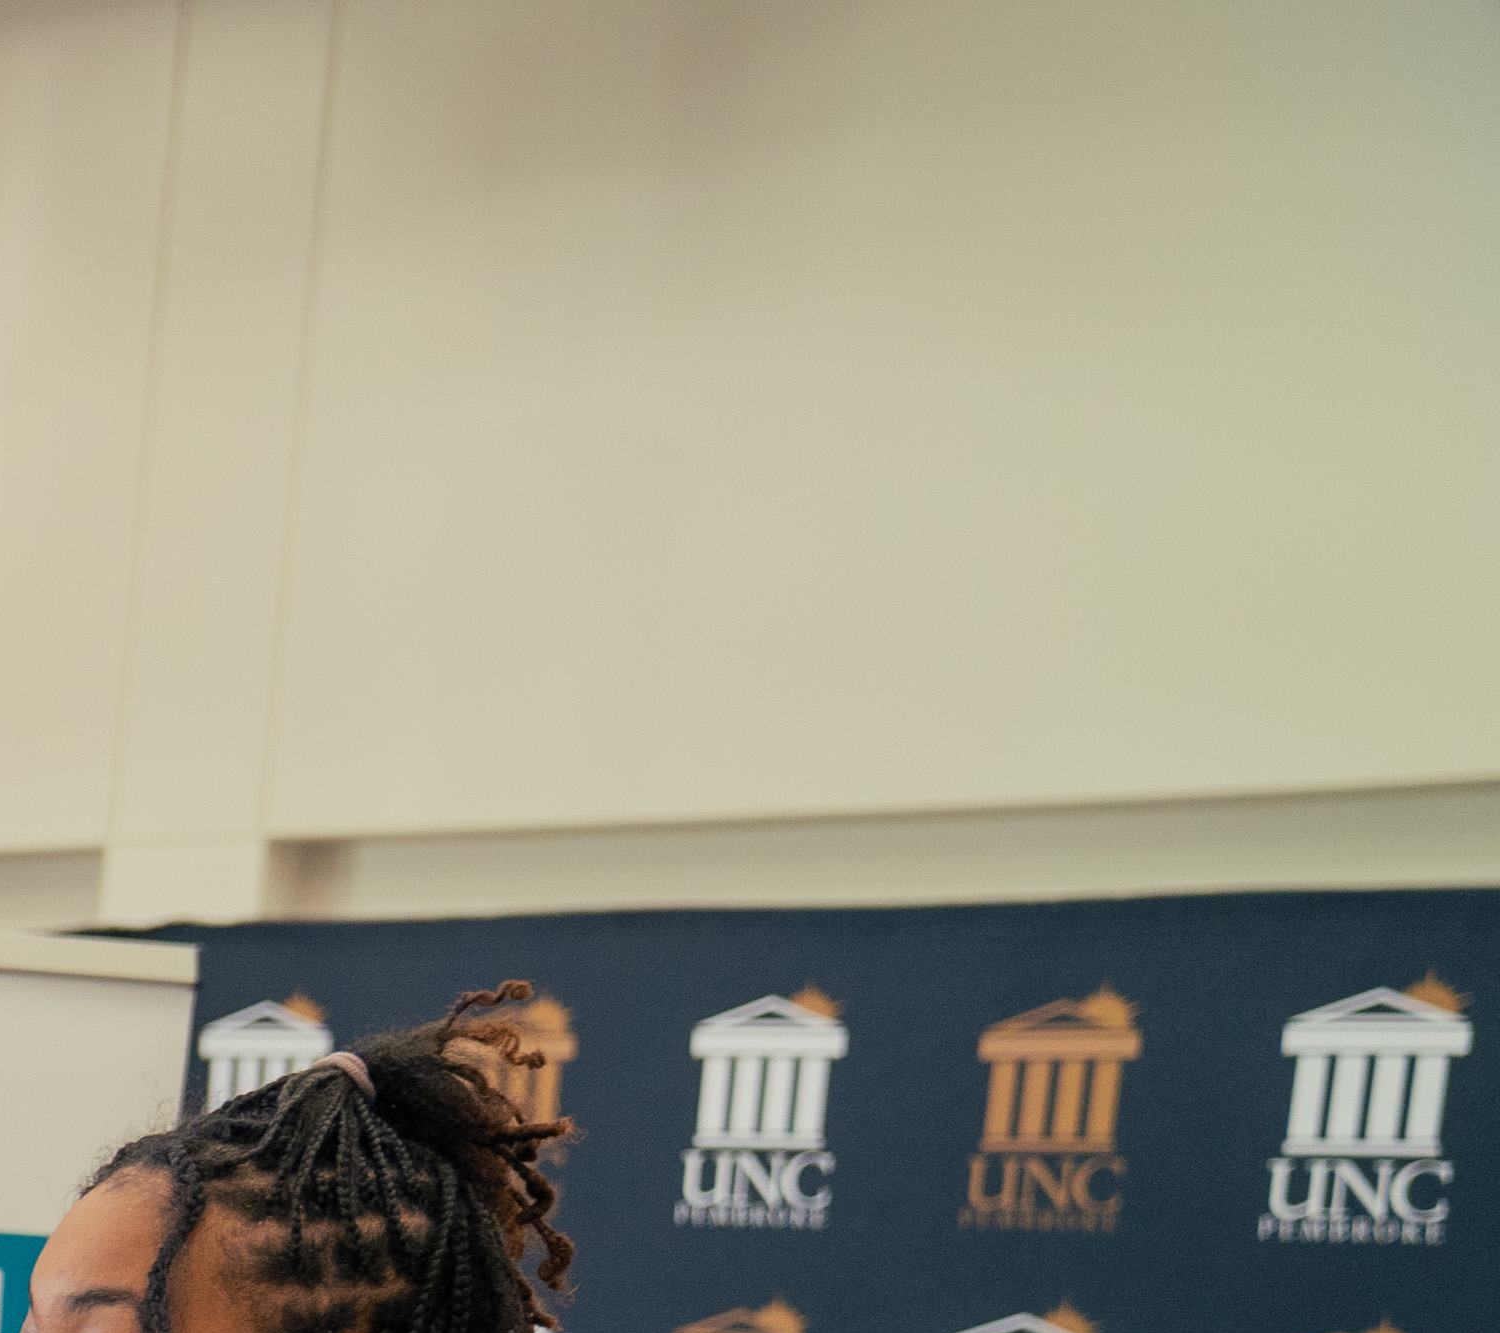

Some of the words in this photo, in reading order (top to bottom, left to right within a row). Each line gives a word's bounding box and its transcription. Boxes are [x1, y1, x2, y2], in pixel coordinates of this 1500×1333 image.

[681, 1148, 836, 1207] UNC
[966, 1154, 1127, 1213] UNC
[1267, 1159, 1454, 1221] UNC
[1257, 1215, 1445, 1246] PEMBROKE
